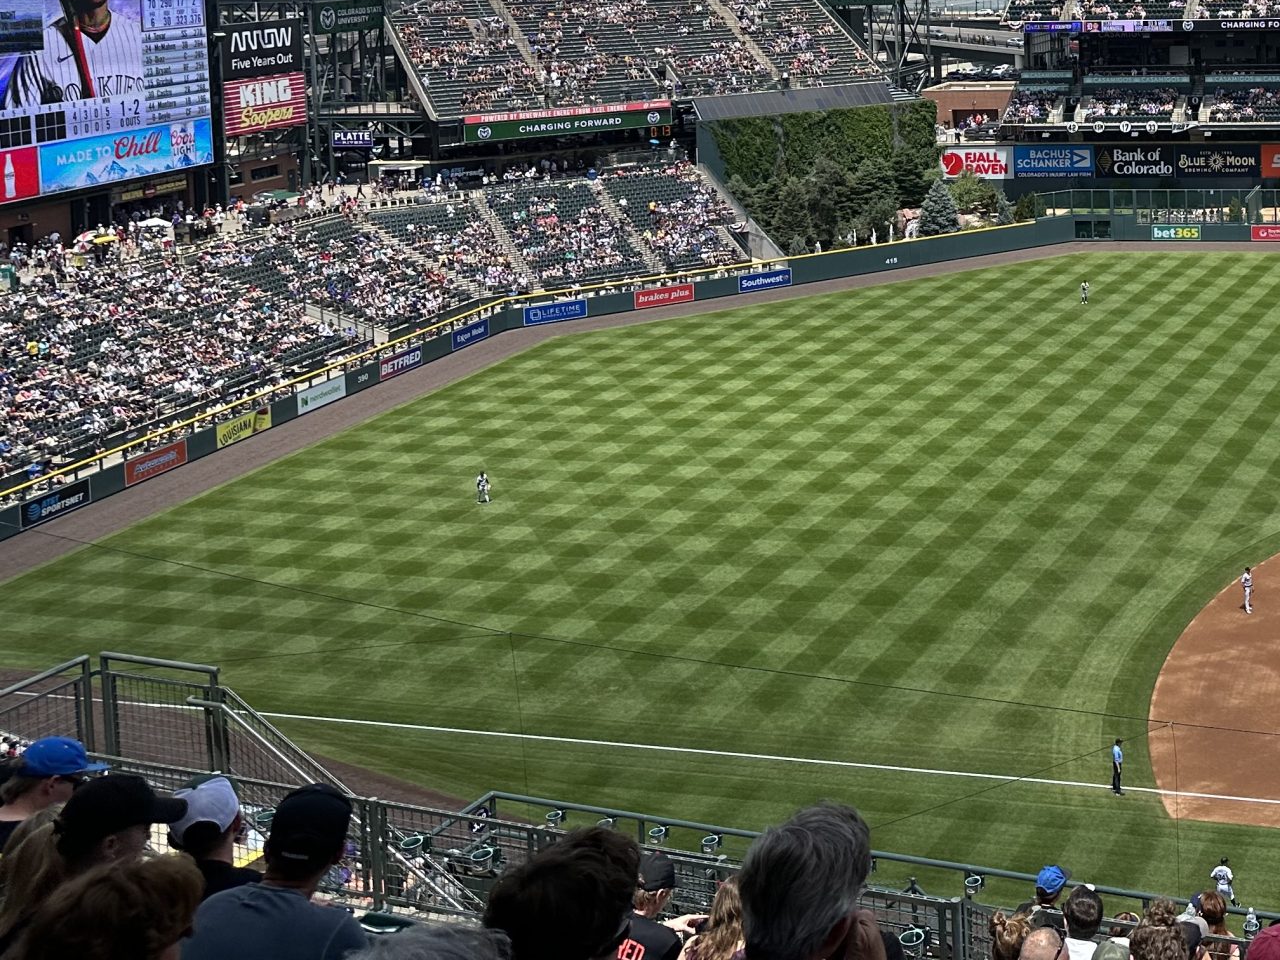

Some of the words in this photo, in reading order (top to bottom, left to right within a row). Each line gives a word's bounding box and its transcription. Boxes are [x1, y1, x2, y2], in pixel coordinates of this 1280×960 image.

[148, 0, 157, 9] 70
[337, 7, 366, 17] COLORADO
[367, 5, 383, 14] STATE
[163, 16, 172, 26] 30
[337, 15, 369, 25] UNIVERSITY
[1221, 21, 1266, 29] CHARGING
[231, 27, 292, 53] ARROW
[231, 58, 251, 70] Five
[251, 55, 276, 67] Years
[276, 53, 293, 64] Out
[239, 78, 292, 108] KING
[72, 111, 77, 121] 4
[84, 110, 88, 120] 3
[240, 106, 294, 129] Soopers
[481, 114, 508, 123] POWERED
[520, 110, 553, 119] RENEWABLE
[553, 108, 574, 117] ENERGY
[575, 107, 591, 115] FROM
[592, 106, 605, 114] XCEL
[606, 104, 627, 112] ENERGY
[126, 116, 141, 127] OUTS
[519, 122, 571, 133] CHARGING
[574, 117, 622, 128] FORWARD
[334, 132, 370, 140] PLATTE
[56, 148, 93, 166] MADE
[96, 145, 113, 159] TO
[114, 131, 163, 160] Chill
[1029, 149, 1071, 158] BACHUS
[1113, 148, 1145, 161] Bank
[1147, 148, 1161, 161] of
[1017, 158, 1071, 168] SCHANKER
[1178, 154, 1206, 168] BLUE
[1226, 155, 1255, 166] MOON
[1113, 161, 1173, 175] Colorado
[1153, 227, 1199, 239] bet365
[741, 275, 784, 288] Southwest
[638, 292, 669, 303] brakes
[670, 288, 690, 300] plus
[541, 304, 581, 316] LIFETIME
[471, 325, 486, 340] Mobil
[380, 350, 421, 376] BETFRED
[357, 373, 369, 383] 390
[218, 418, 252, 447] LOUISIANA
[40, 492, 85, 517] SPORTSNET
[41, 494, 60, 508] AT&T
